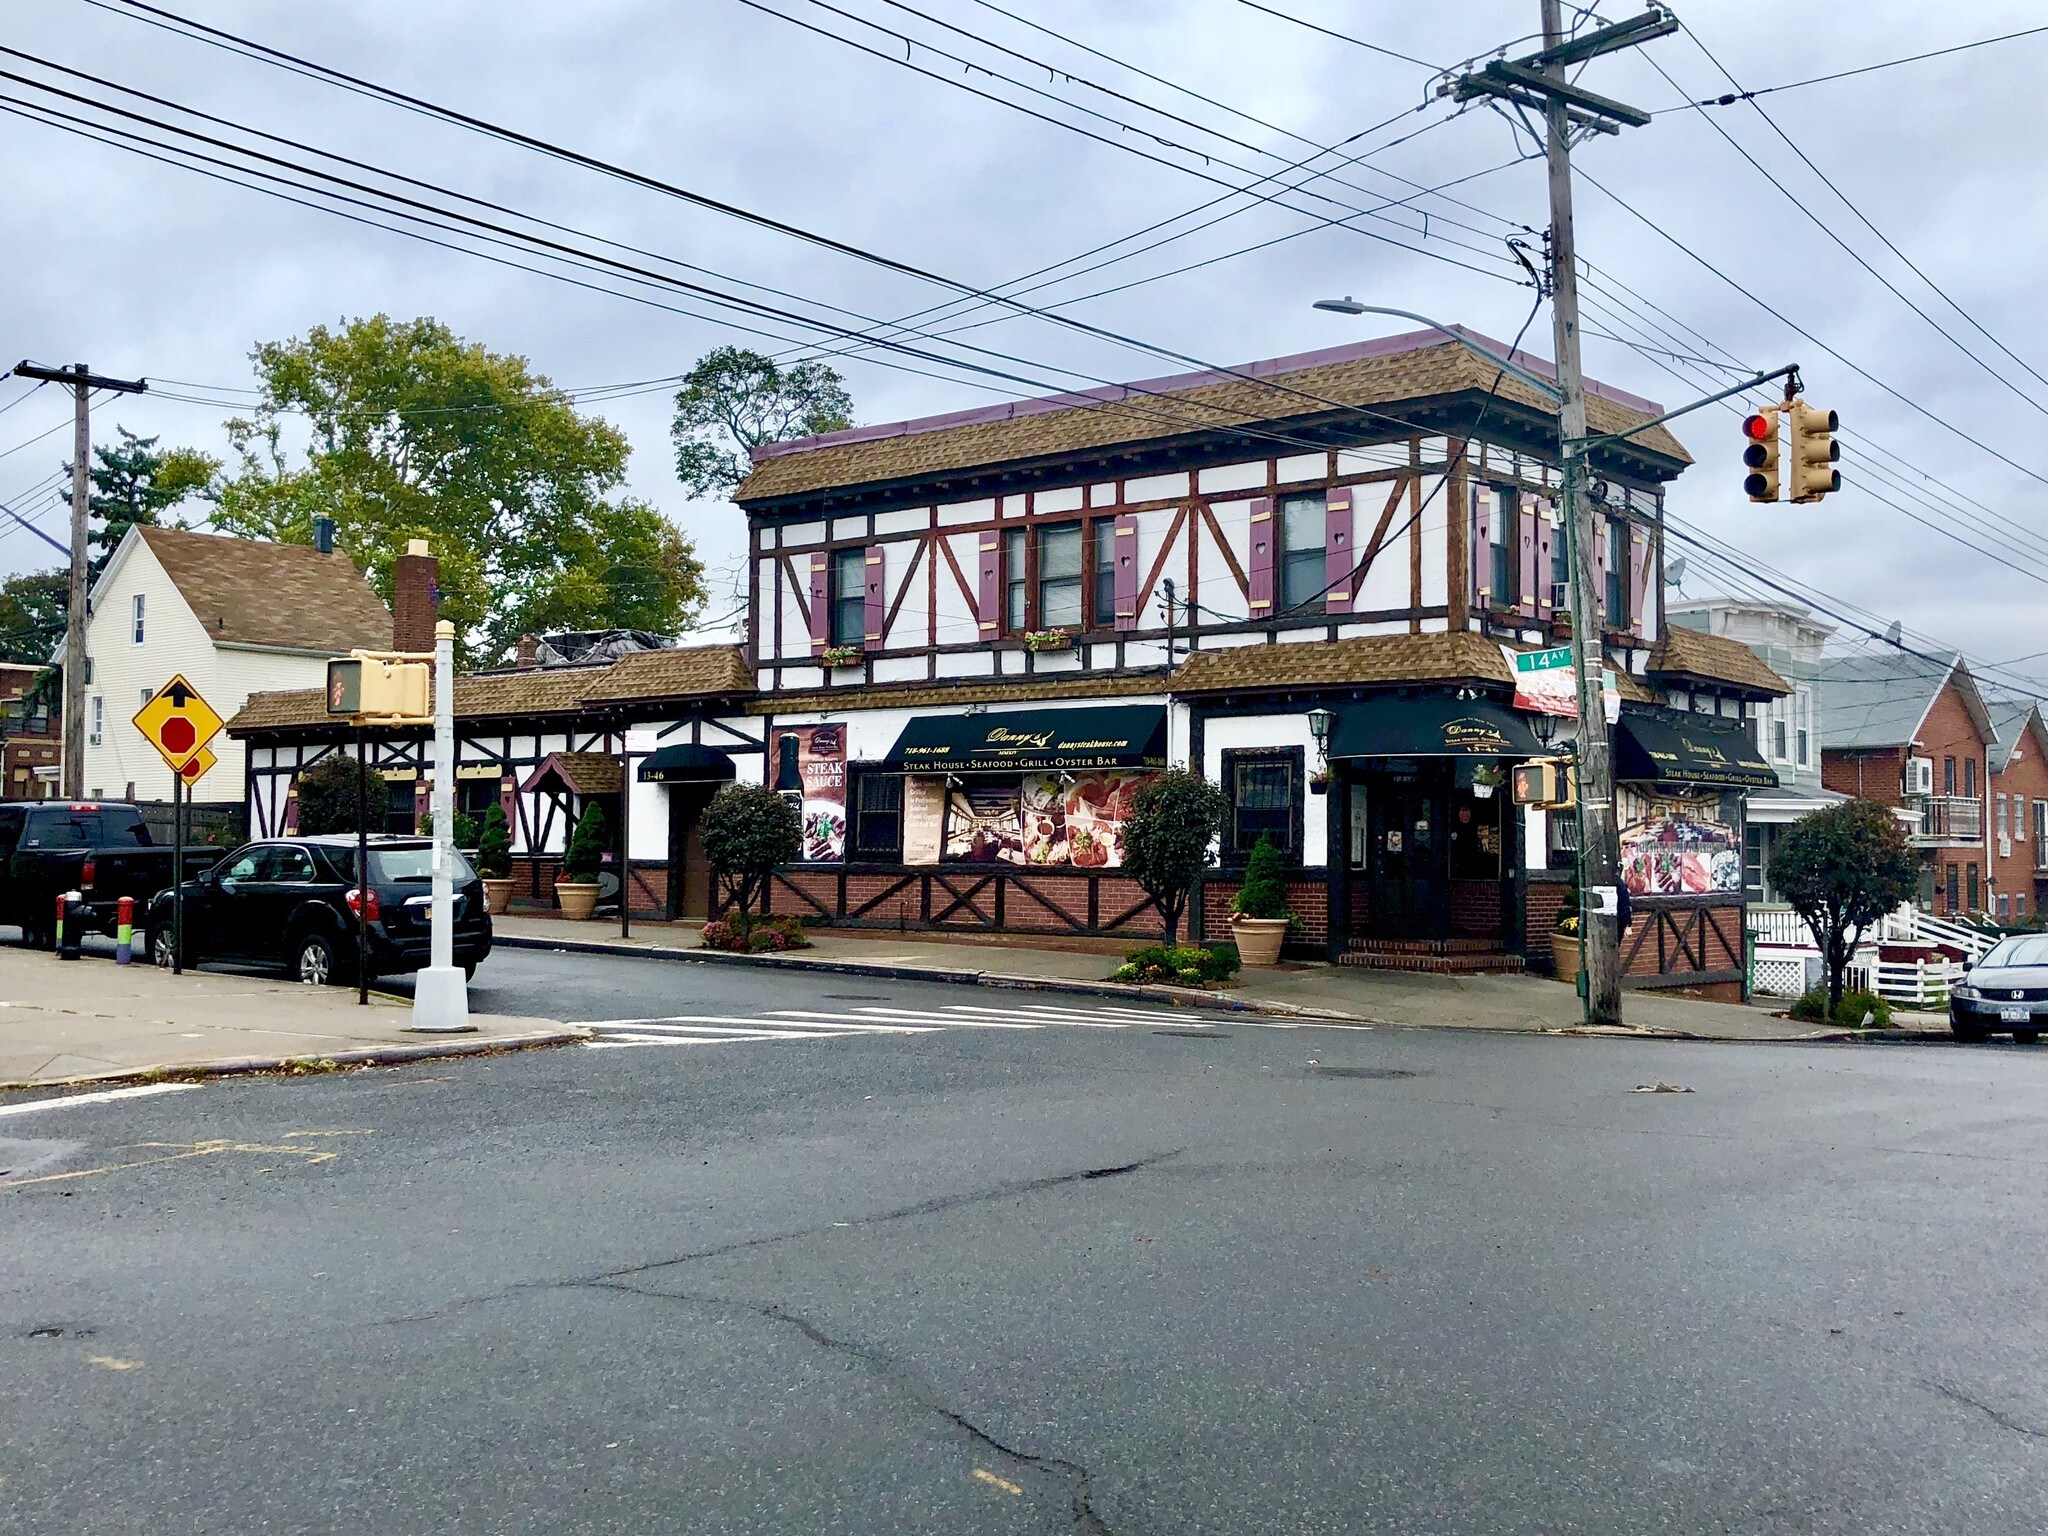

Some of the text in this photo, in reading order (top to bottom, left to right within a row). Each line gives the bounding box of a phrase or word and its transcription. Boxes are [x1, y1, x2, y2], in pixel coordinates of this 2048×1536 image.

[1529, 650, 1565, 670] 14 AV
[986, 727, 1054, 747] Danny's
[807, 762, 844, 774] STEAK
[904, 756, 1117, 770] STEAK HOUSE SEAFOOD GRILL OYSTER BAR
[643, 771, 664, 780] 13-46
[806, 775, 842, 787] SAUCE
